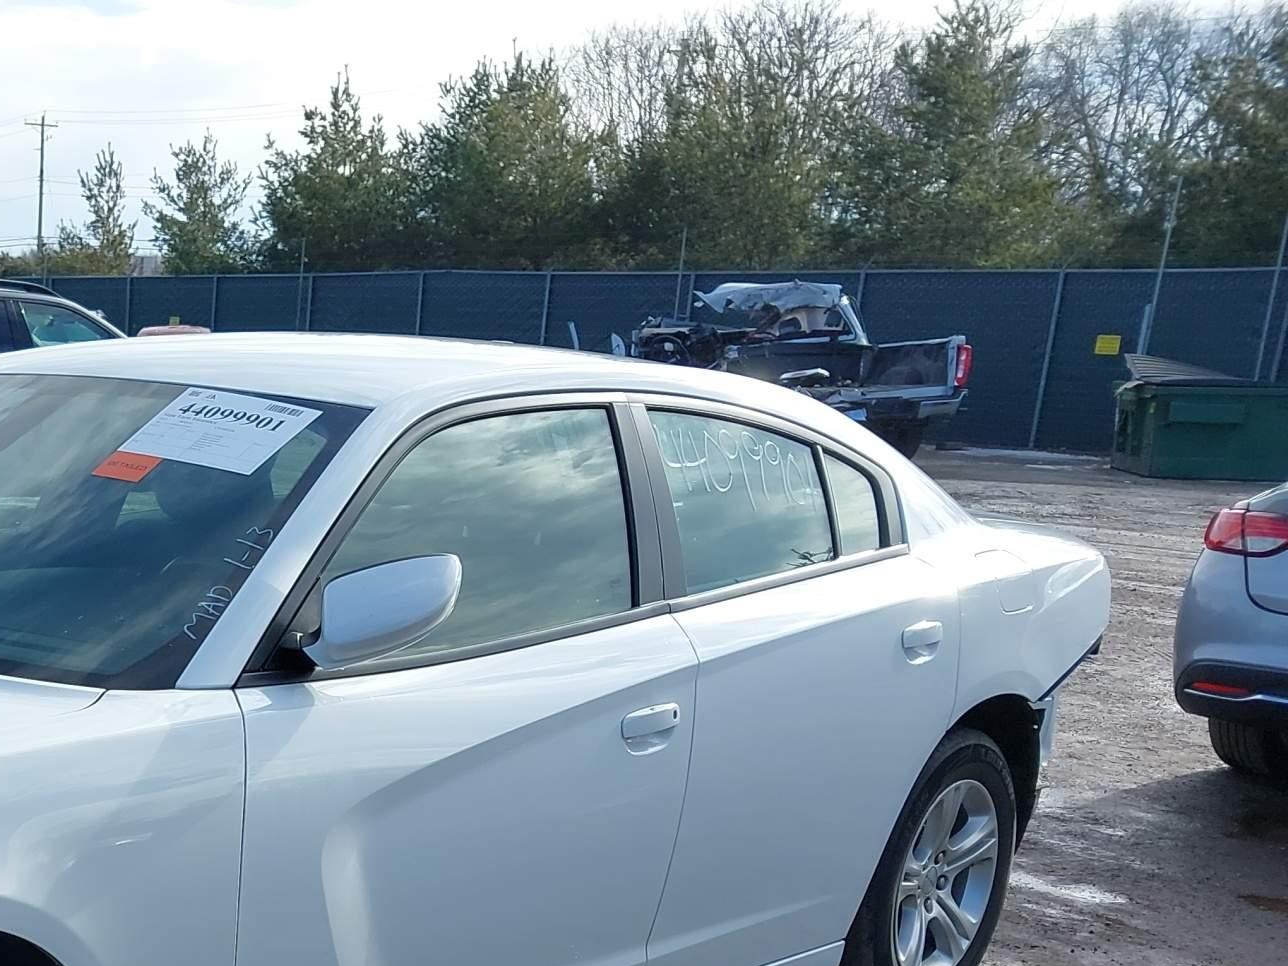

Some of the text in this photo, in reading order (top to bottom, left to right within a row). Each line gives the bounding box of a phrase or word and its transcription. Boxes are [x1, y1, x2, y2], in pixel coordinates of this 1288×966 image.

[178, 402, 286, 432] 44099901
[653, 423, 817, 512] 44099901
[184, 586, 233, 640] MAD
